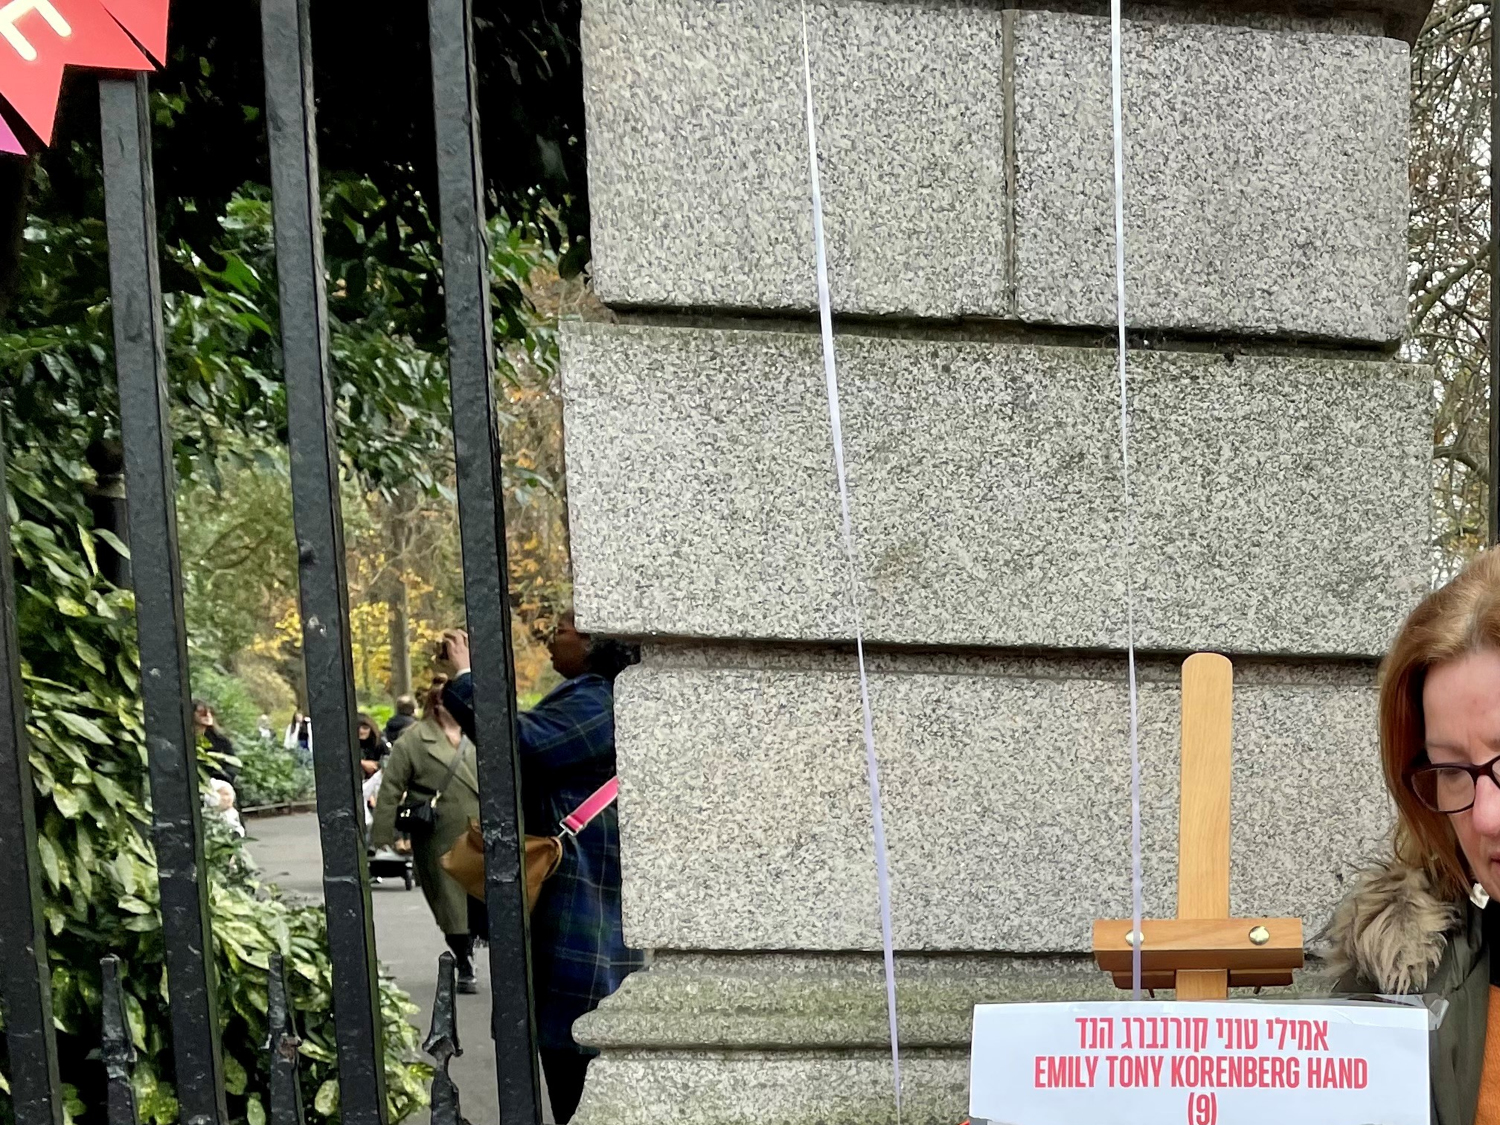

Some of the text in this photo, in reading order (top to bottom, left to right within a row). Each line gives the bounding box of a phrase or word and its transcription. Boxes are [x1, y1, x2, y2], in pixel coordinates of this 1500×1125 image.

[1075, 1017, 1329, 1052] אמילי טוני קורנברג הנד
[1034, 1055, 1368, 1090] EMILY TONY KORENBERG HAND
